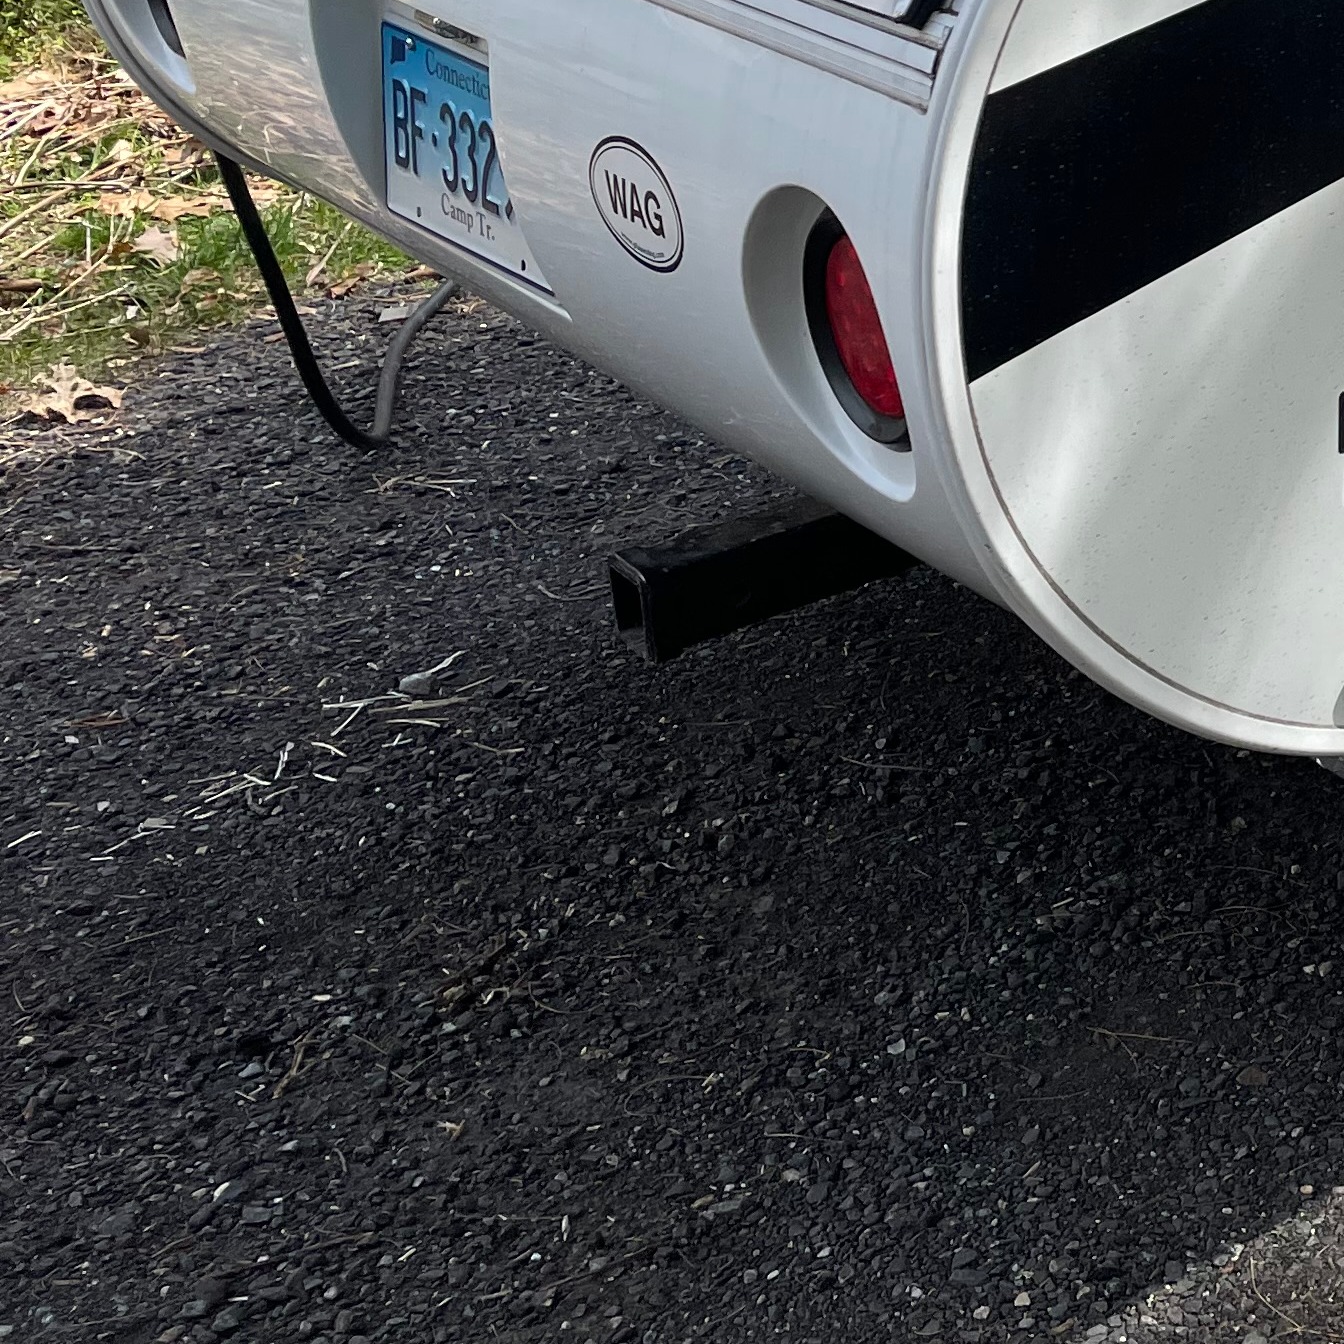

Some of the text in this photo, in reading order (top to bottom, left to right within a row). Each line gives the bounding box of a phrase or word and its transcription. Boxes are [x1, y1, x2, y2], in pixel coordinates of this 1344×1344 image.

[425, 48, 490, 100] Connectic
[441, 193, 474, 232] Camp
[604, 169, 666, 239] WAG
